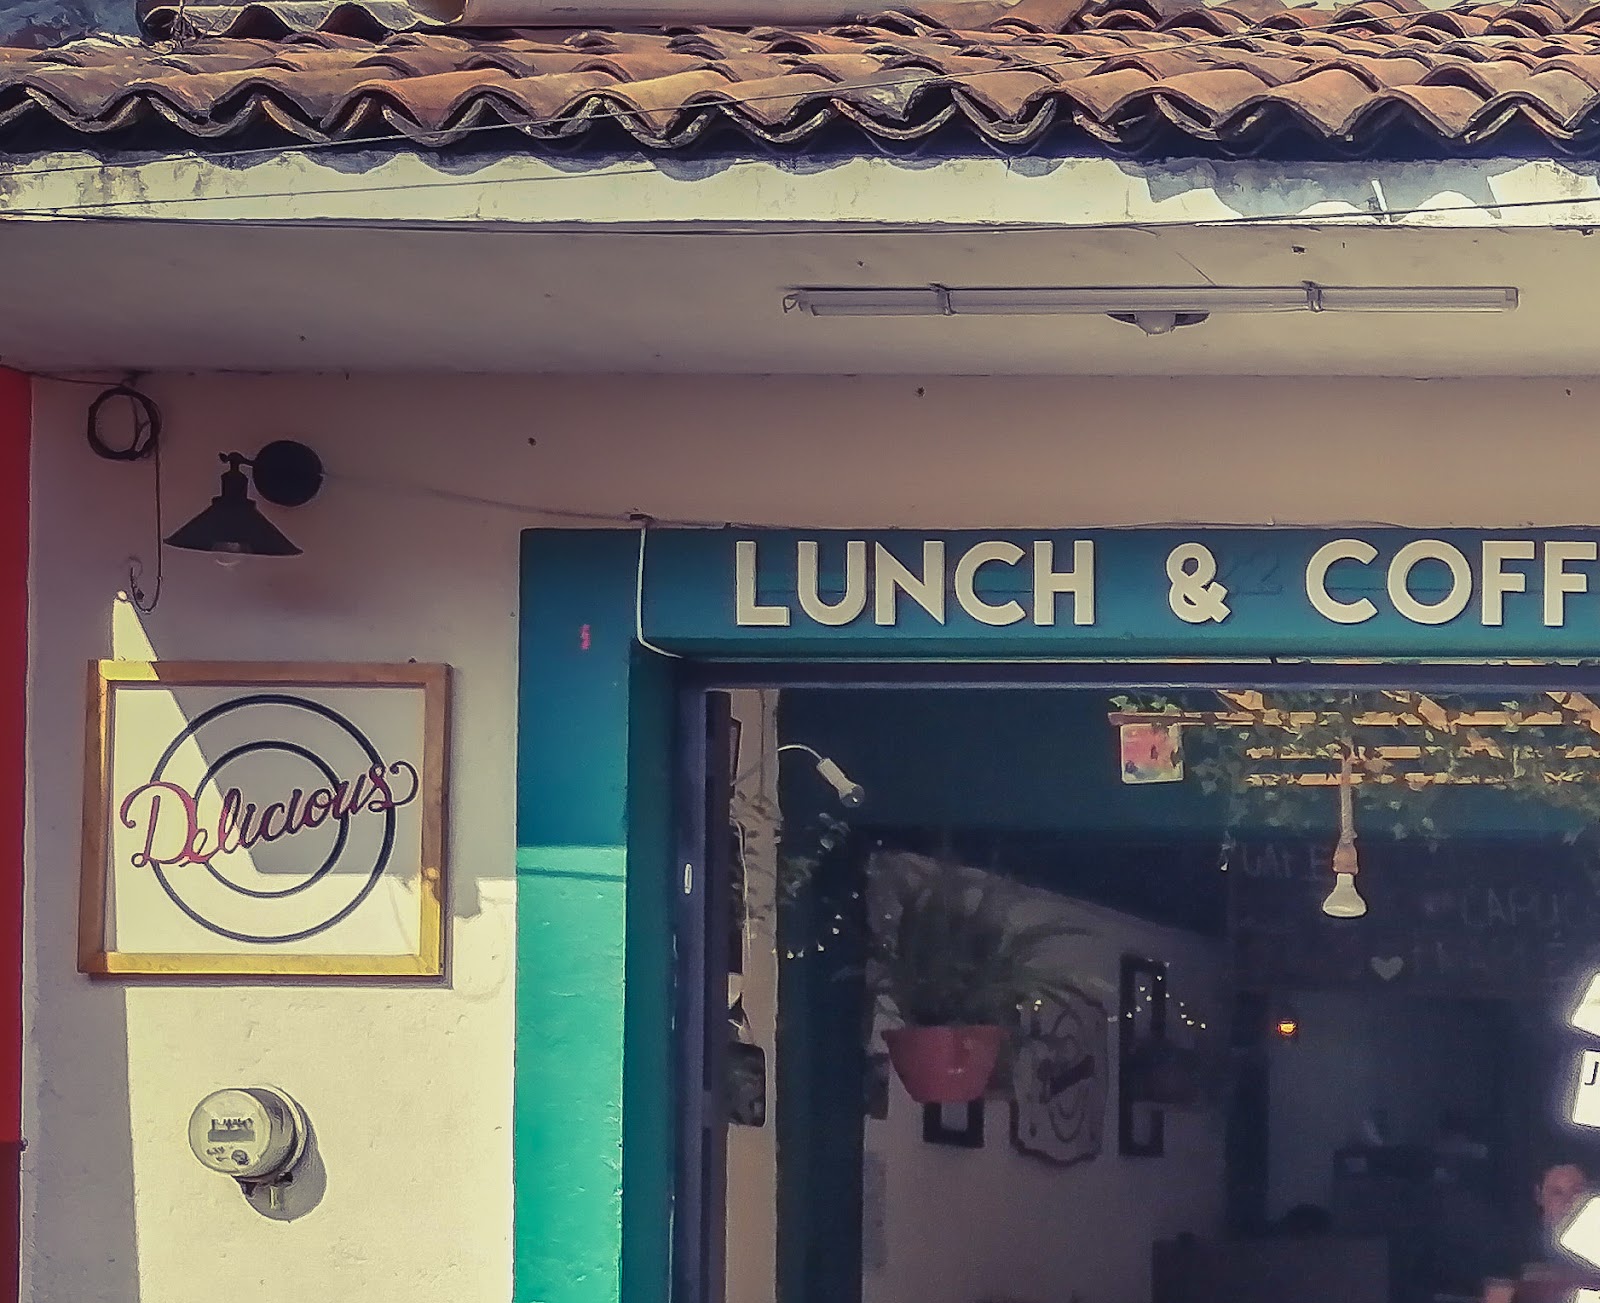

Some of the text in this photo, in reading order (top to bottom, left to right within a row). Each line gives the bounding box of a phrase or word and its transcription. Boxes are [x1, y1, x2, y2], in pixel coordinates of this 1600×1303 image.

[736, 540, 1095, 626] LUNCH
[1166, 542, 1232, 623] &
[120, 760, 418, 867] Delicious
